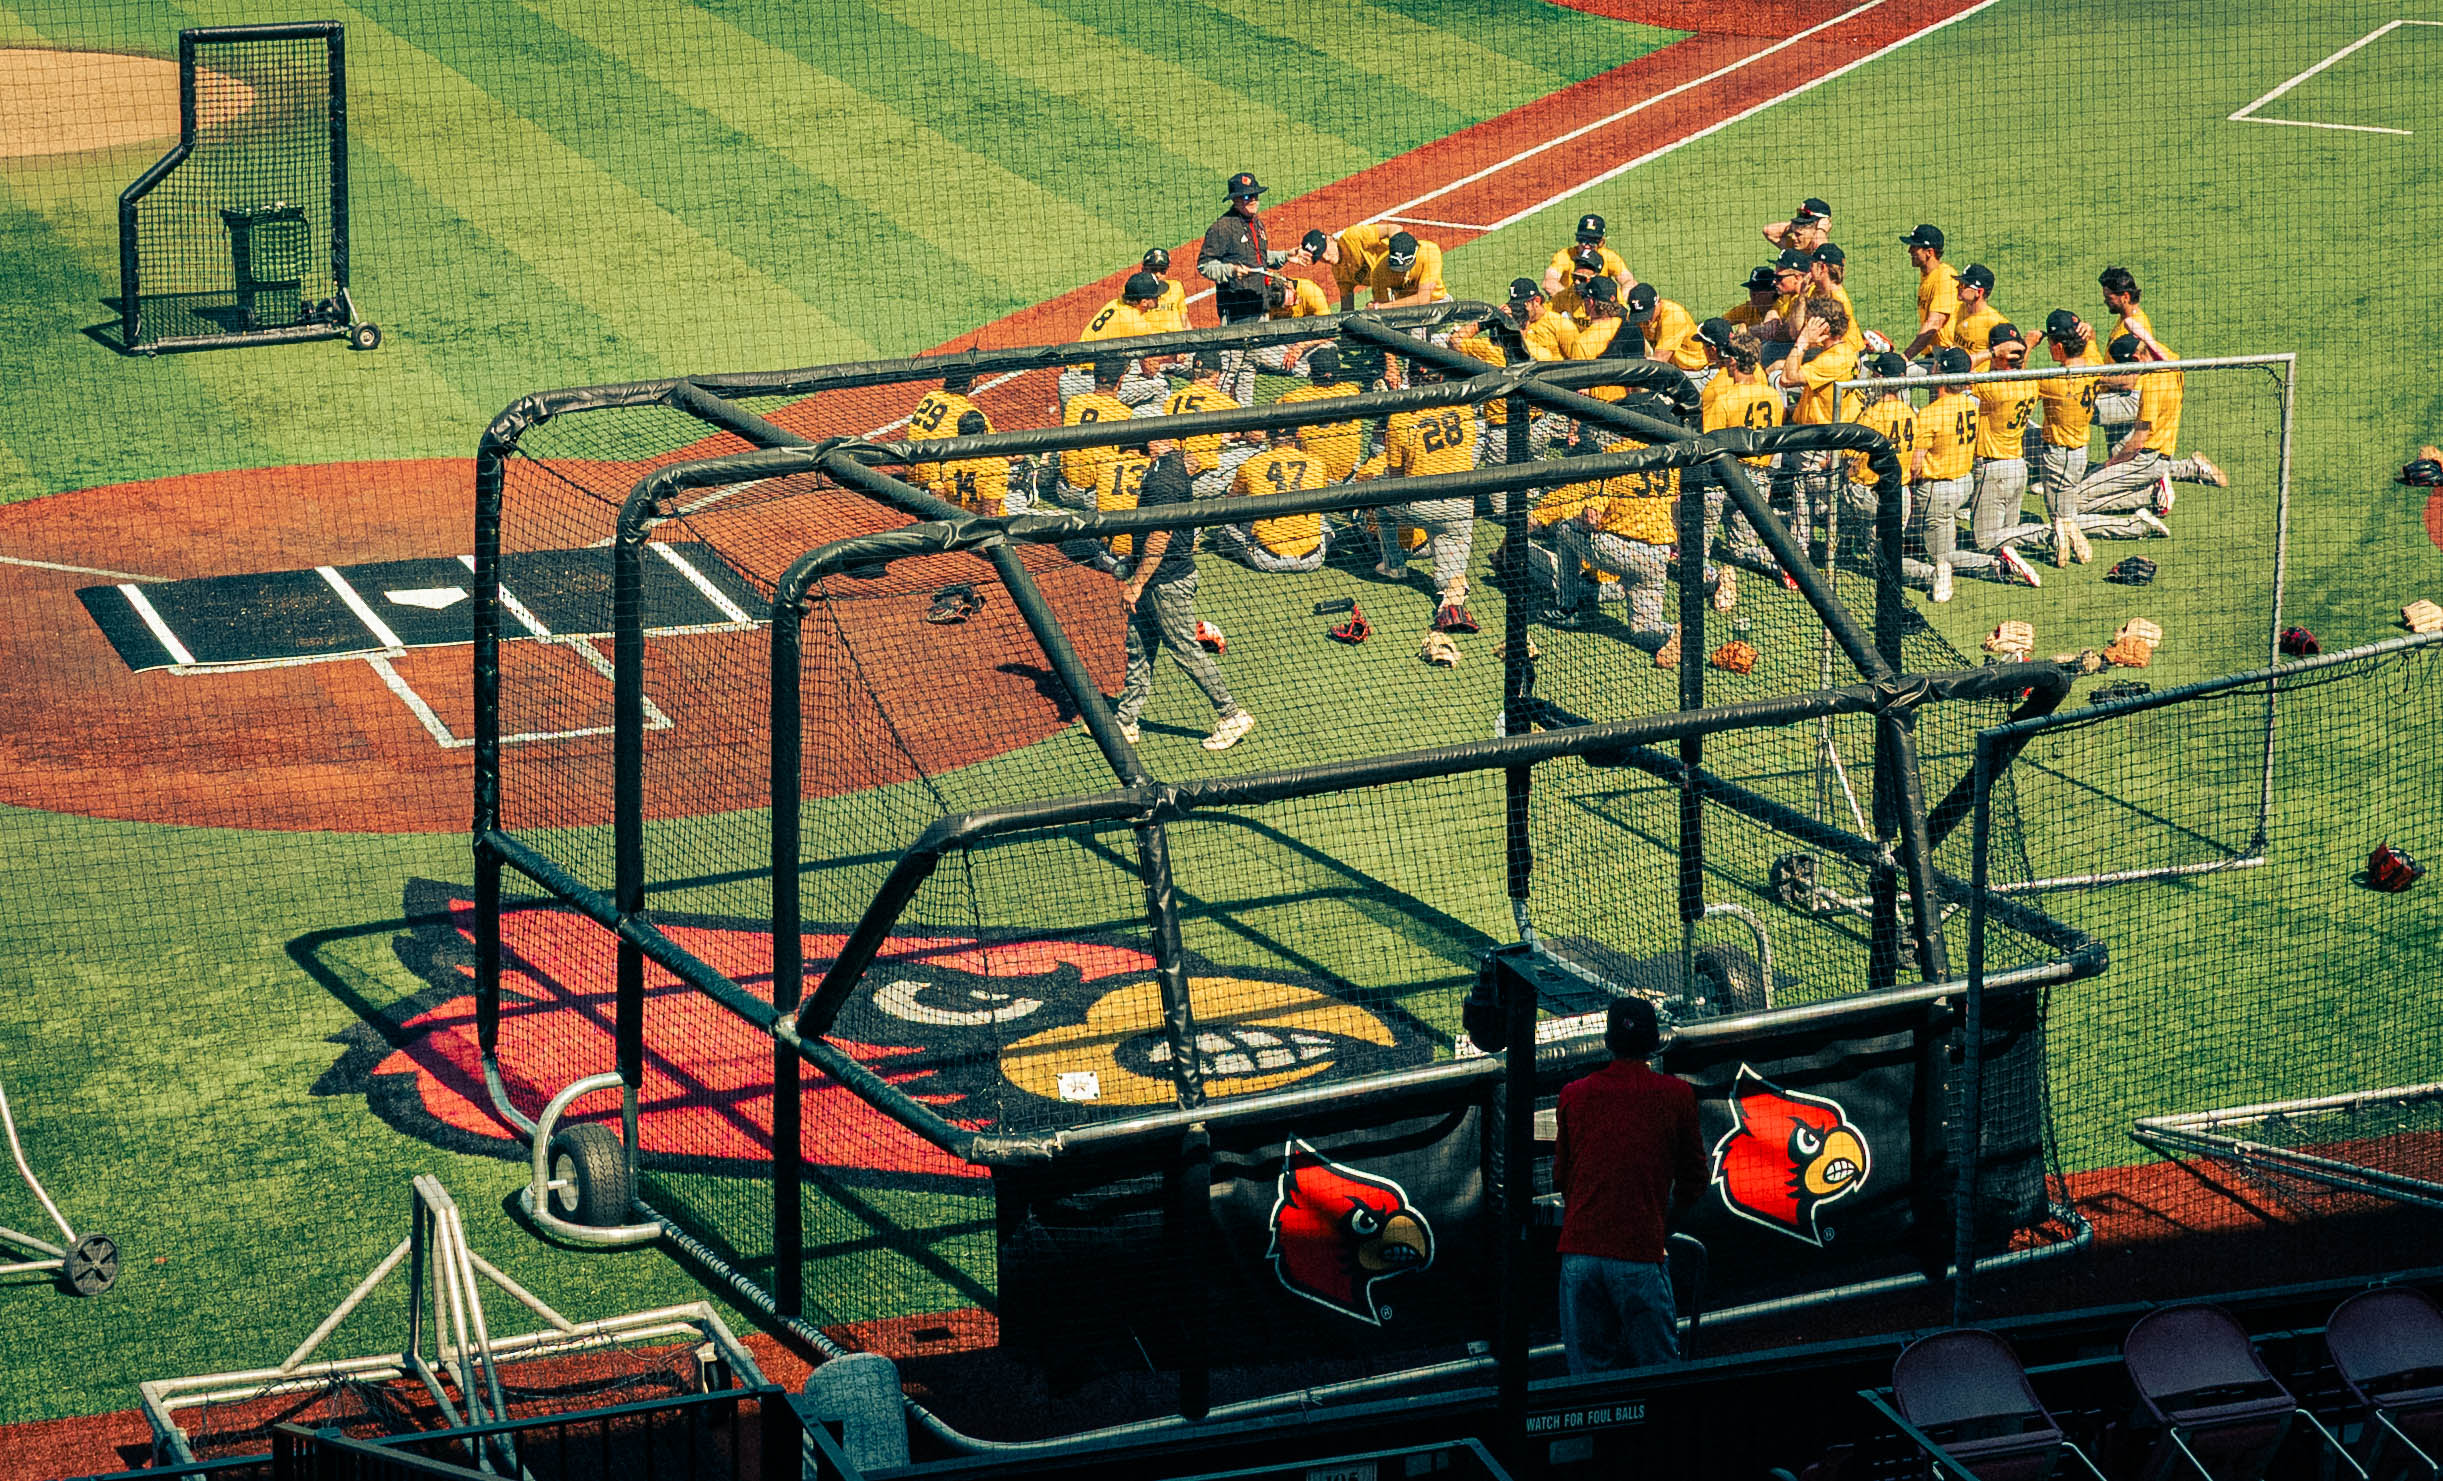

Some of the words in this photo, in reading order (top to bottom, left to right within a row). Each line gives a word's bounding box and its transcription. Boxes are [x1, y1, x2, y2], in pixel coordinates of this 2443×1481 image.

[1092, 308, 1115, 332] 8
[912, 398, 948, 432] 29
[1744, 401, 1773, 431] 43
[1956, 410, 1977, 445] 45
[1419, 412, 1464, 453] 28
[1889, 418, 1914, 451] 44
[1266, 461, 1307, 492] 47
[1526, 1415, 1560, 1432] WATCH
[1564, 1412, 1583, 1428] FOR
[1588, 1408, 1612, 1424] FOUL
[1615, 1404, 1645, 1421] BALLS
